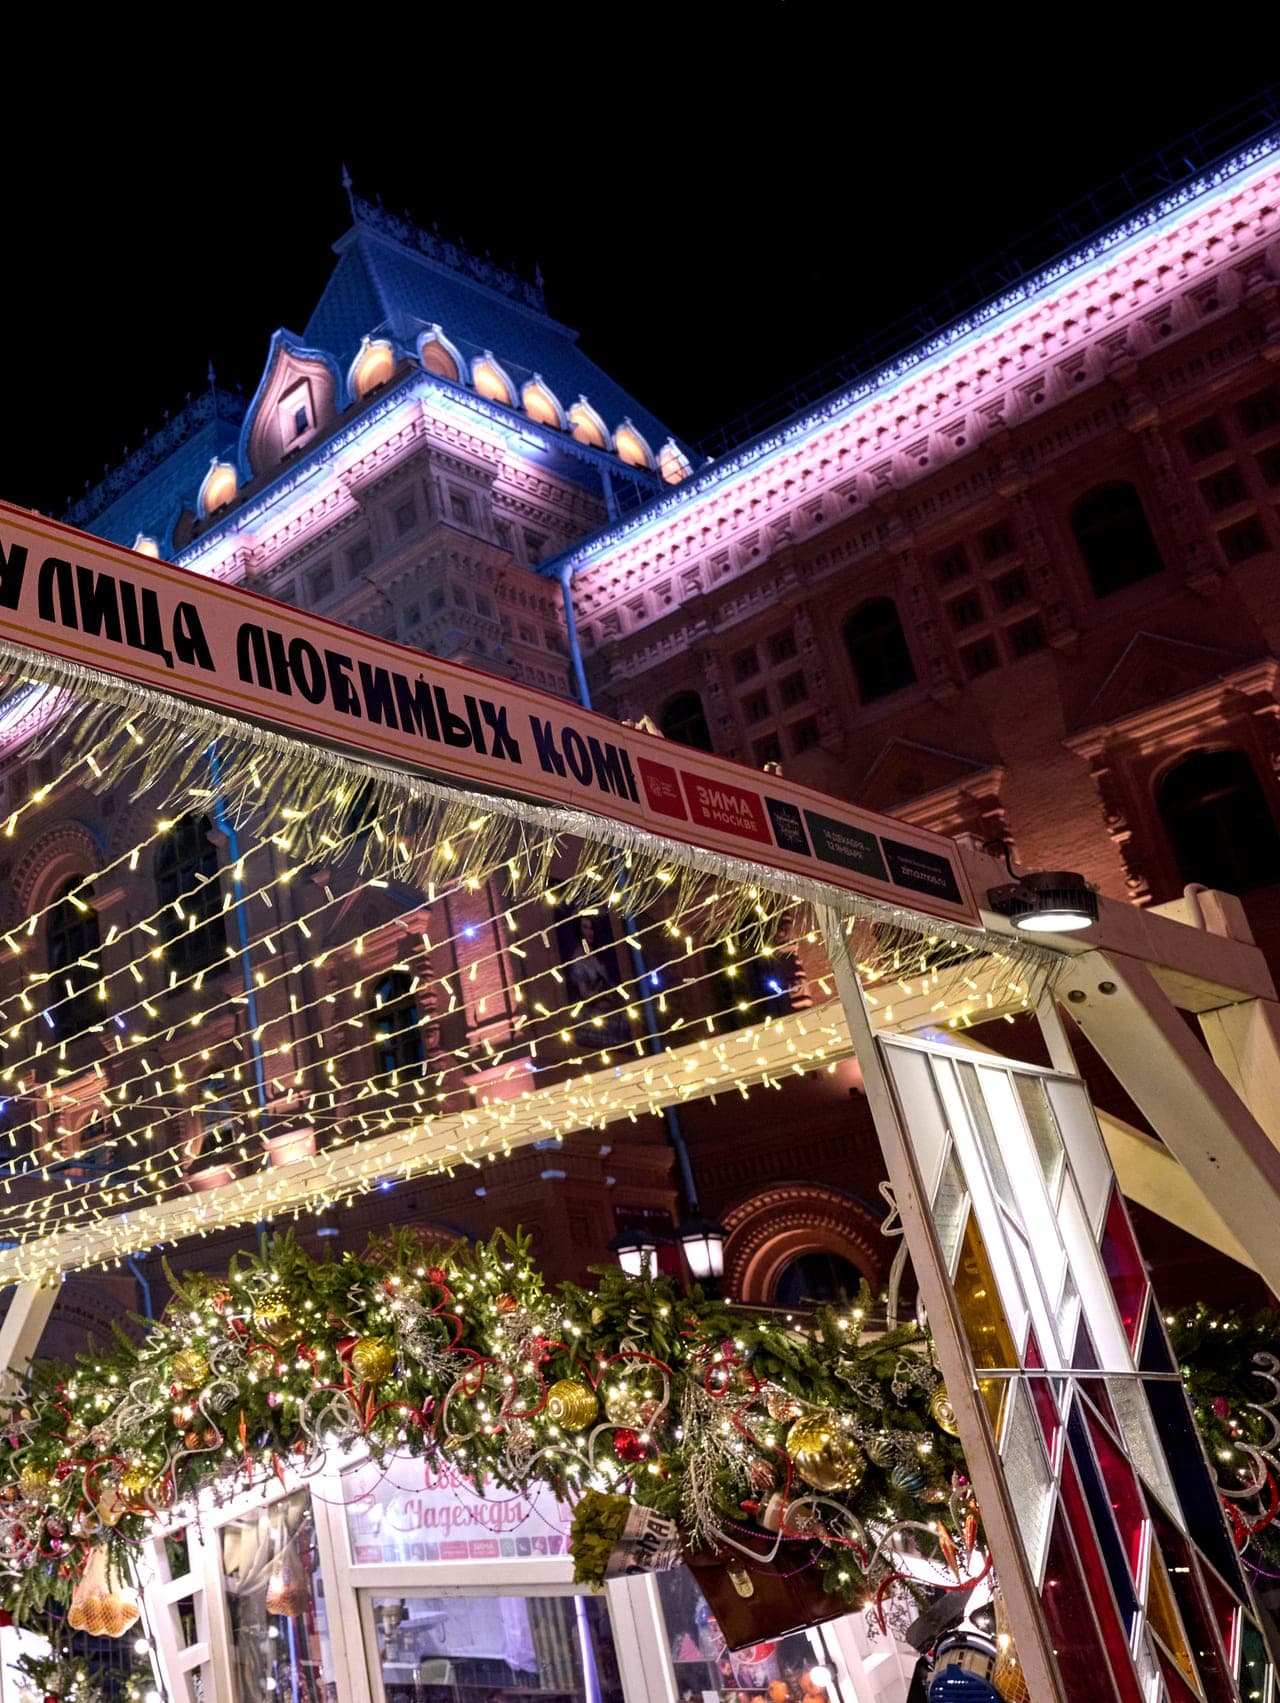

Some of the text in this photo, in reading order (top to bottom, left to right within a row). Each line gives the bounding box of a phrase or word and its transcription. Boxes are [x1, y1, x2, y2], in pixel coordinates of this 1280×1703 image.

[236, 622, 523, 764] ЛЮБИМЫХ
[696, 785, 754, 819] ЗИМА
[713, 810, 759, 832] МОСКВЕ
